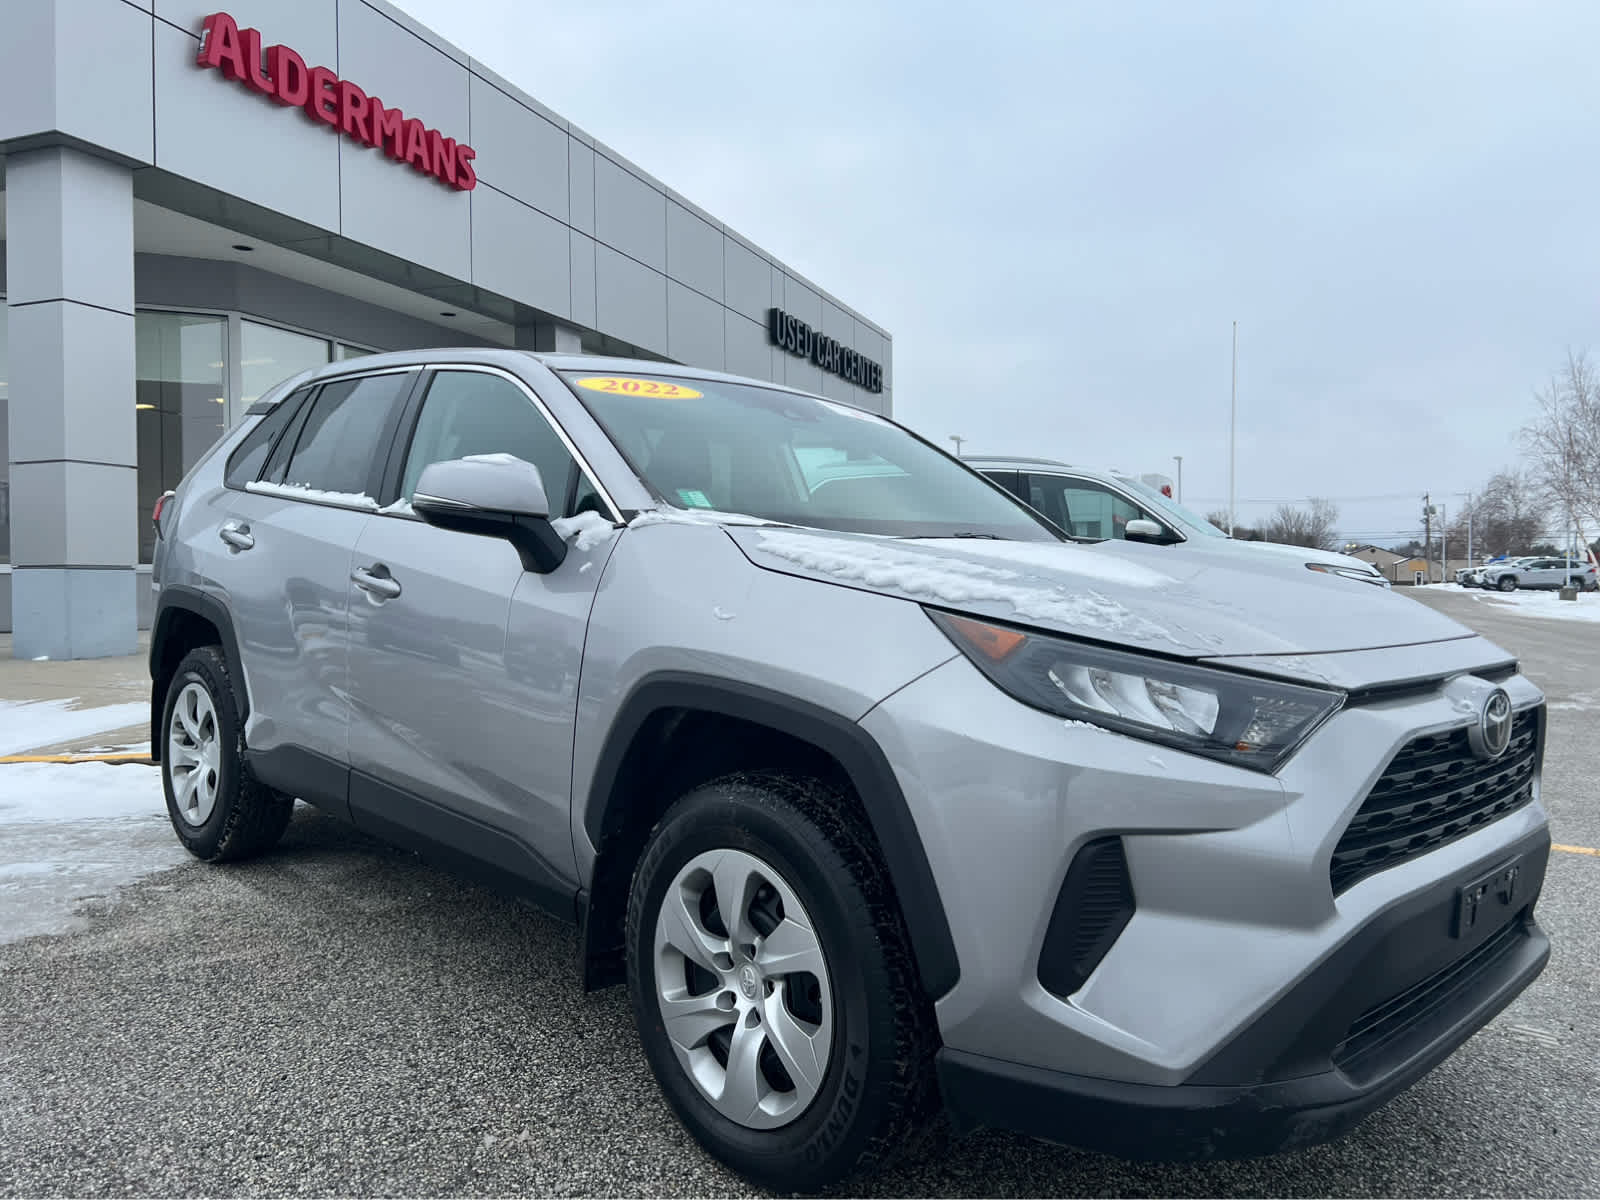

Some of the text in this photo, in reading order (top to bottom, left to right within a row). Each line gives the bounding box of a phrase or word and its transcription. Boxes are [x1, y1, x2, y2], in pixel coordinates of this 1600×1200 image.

[198, 12, 476, 191] ALDERMANS
[602, 380, 681, 396] 2022
[770, 308, 882, 393] USED CAR CENTER
